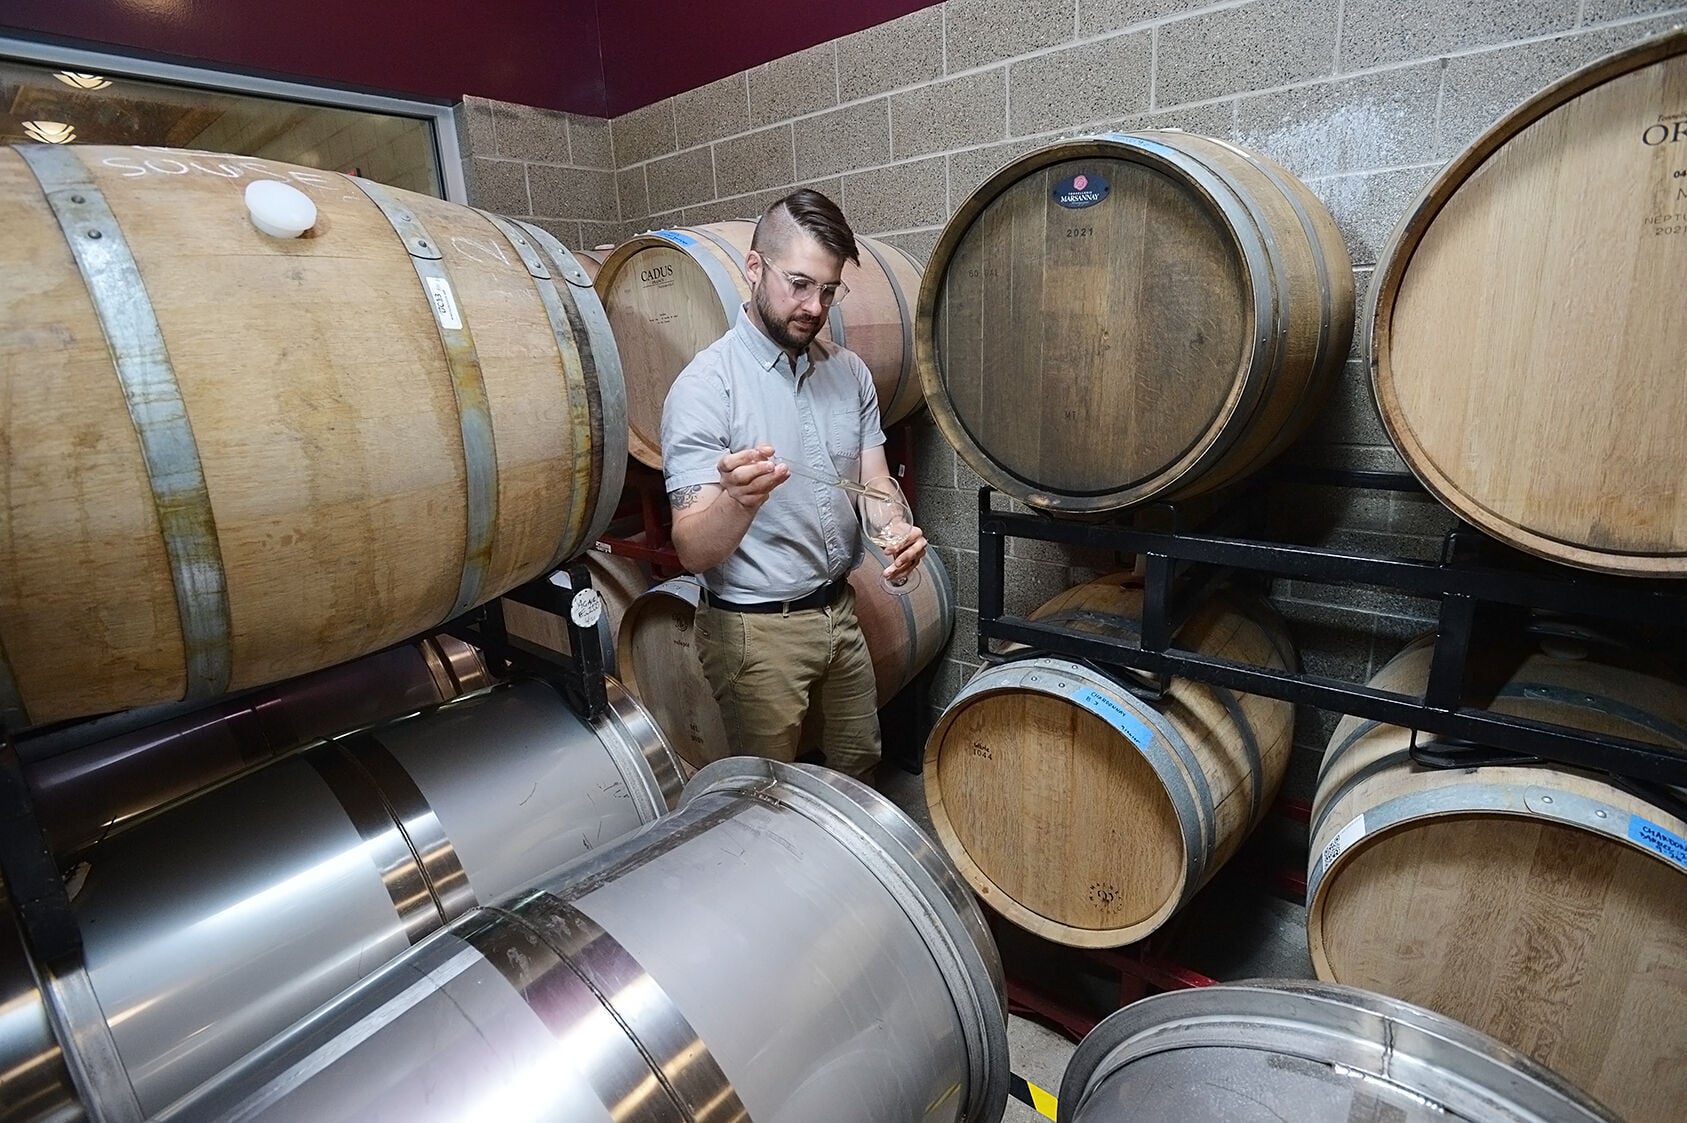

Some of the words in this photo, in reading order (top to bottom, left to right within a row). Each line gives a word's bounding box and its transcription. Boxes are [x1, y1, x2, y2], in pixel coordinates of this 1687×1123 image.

[1060, 193, 1100, 203] MARSANNAY
[1067, 227, 1094, 238] 2021
[640, 264, 674, 282] CADUS
